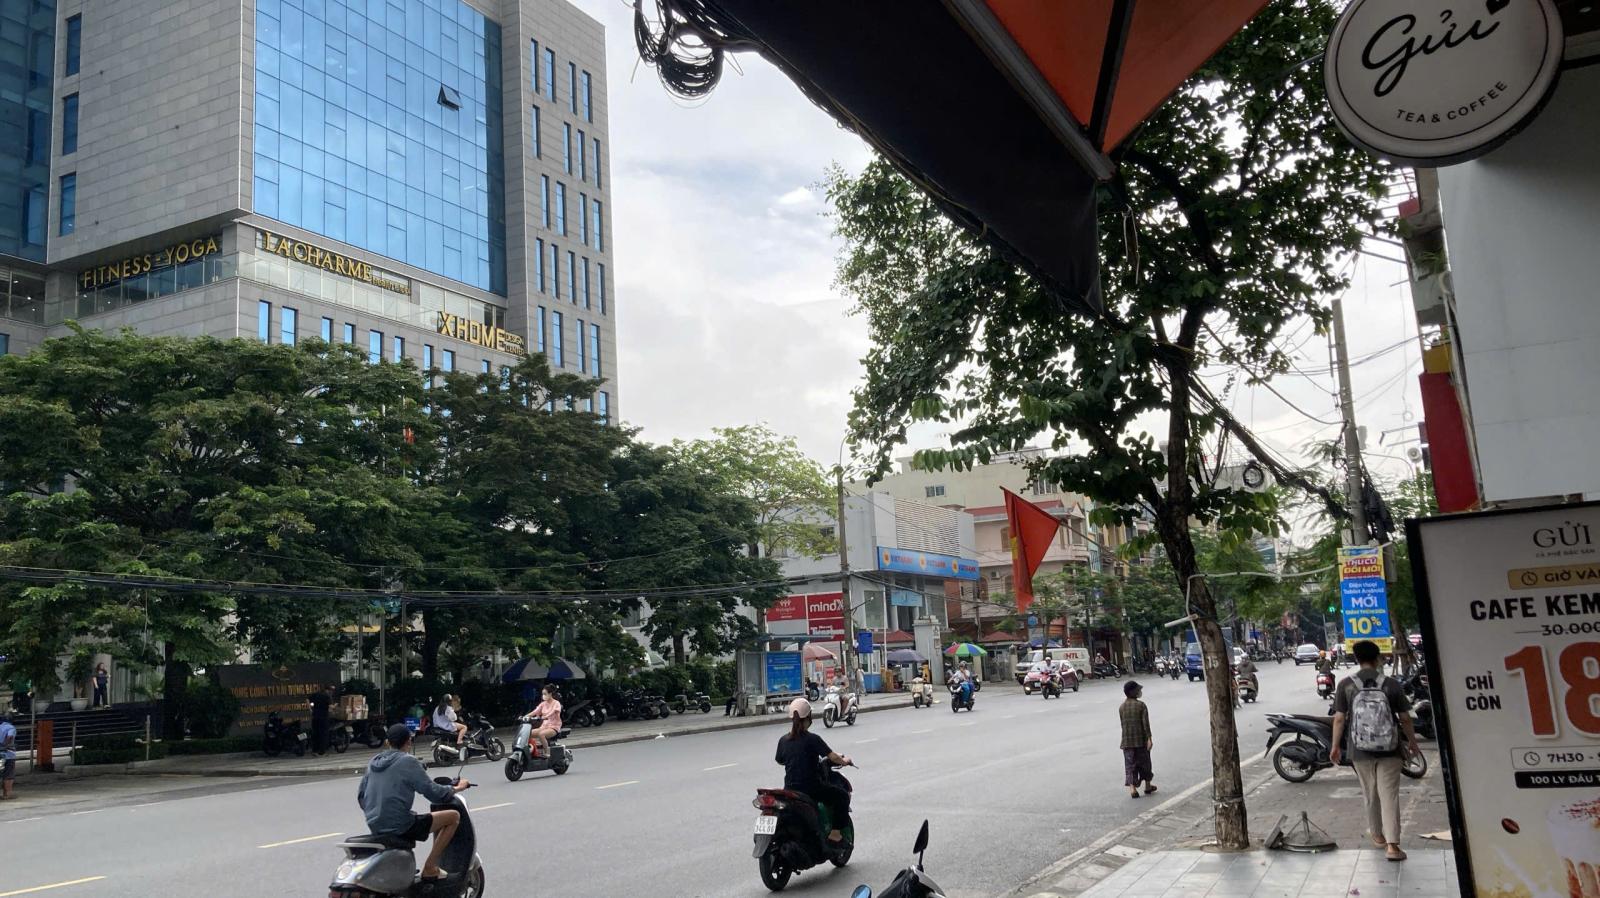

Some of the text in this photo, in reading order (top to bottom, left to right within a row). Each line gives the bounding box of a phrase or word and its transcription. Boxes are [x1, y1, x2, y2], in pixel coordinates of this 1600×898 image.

[1396, 80, 1508, 123] TEA & COFFEE
[84, 236, 218, 288] FITNESS YOGA
[1532, 521, 1592, 548] GỬI
[1544, 569, 1572, 583] GIỜ
[1351, 594, 1378, 608] MỚI
[1470, 592, 1600, 621] CAFE KEM
[1348, 616, 1382, 635] 10%
[1465, 671, 1494, 690] CHỈ
[1466, 695, 1502, 711] CÒN
[1547, 753, 1584, 763] 7H30
[1530, 775, 1549, 784] 100
[1553, 776, 1565, 784] LY
[1568, 773, 1593, 784] ĐẦU
